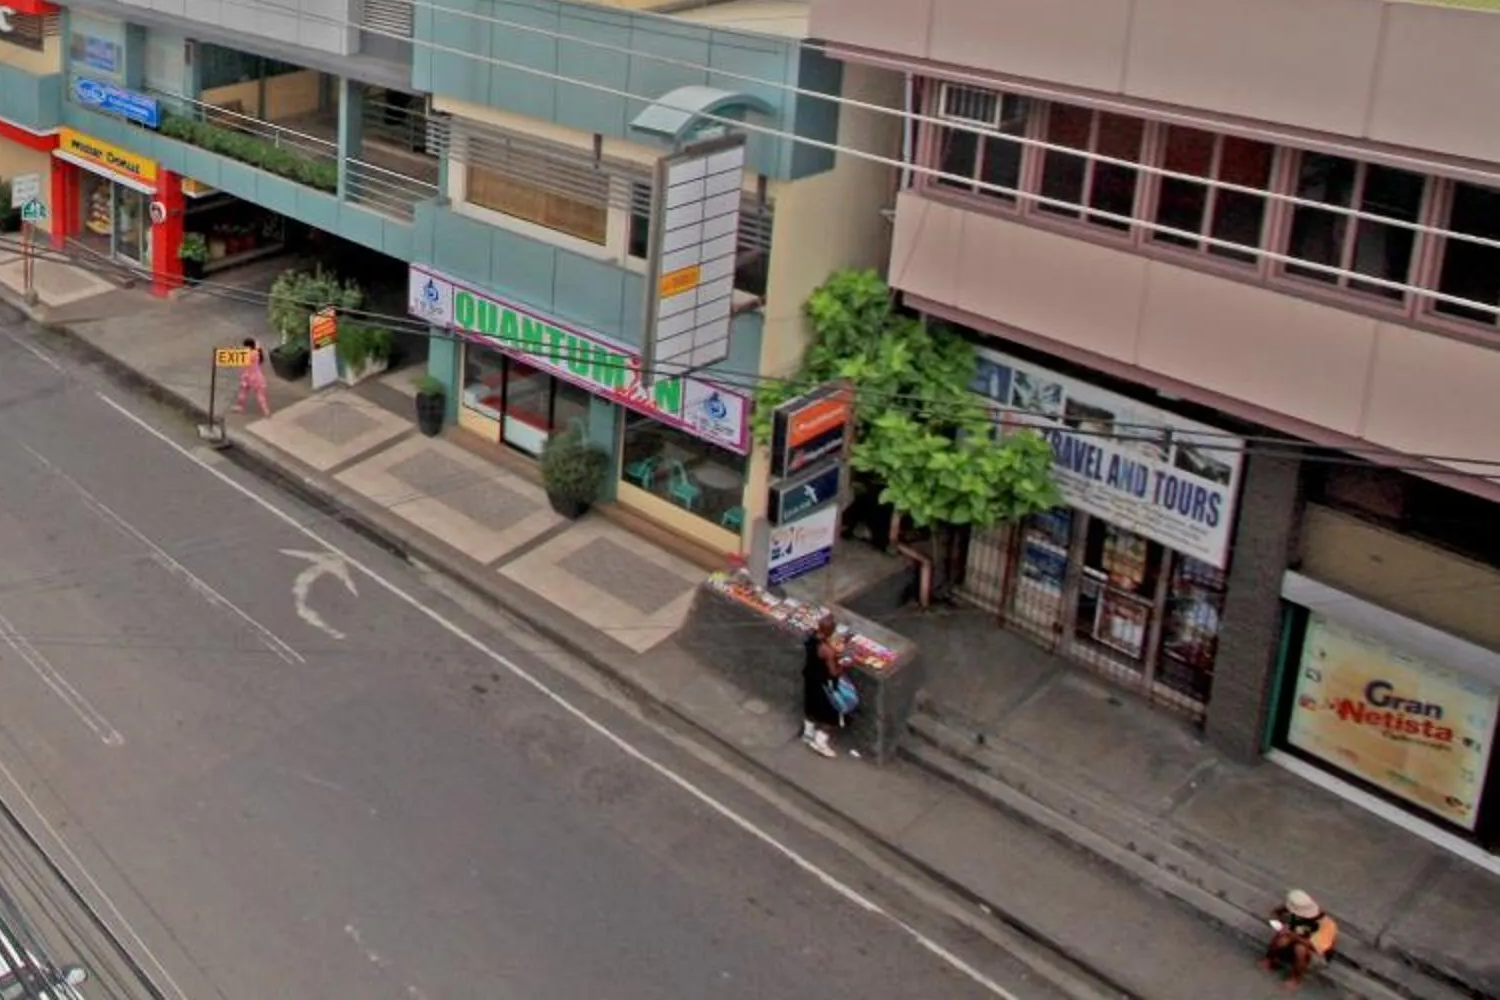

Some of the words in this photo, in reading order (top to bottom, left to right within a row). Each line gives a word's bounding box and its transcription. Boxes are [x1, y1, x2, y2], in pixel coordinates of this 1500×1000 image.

[218, 351, 248, 364] EXIT
[1107, 453, 1148, 499] AND
[1154, 470, 1223, 529] TOURS
[1334, 697, 1454, 743] Netista
[1364, 679, 1444, 720] Gran
